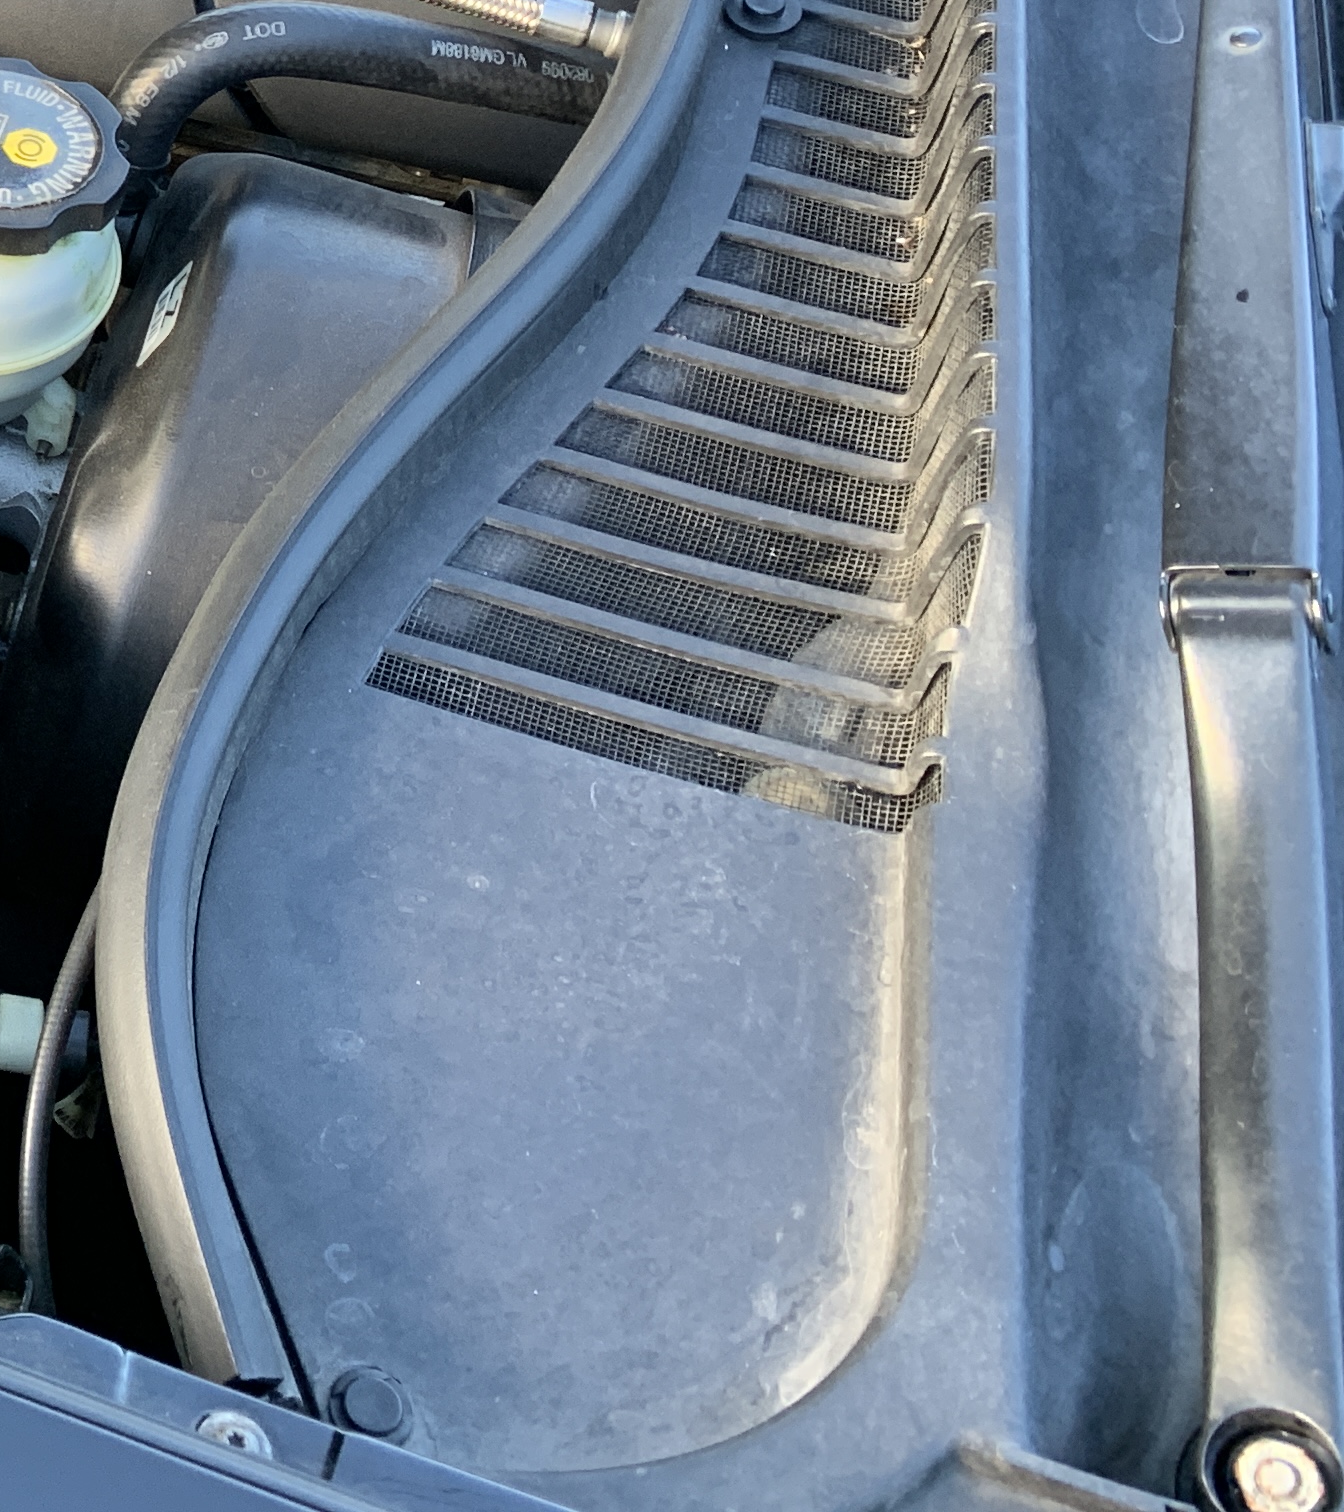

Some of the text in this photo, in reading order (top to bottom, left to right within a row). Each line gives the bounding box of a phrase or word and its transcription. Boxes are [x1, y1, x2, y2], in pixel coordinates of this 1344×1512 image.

[242, 21, 286, 41] DOT
[3, 80, 58, 107] FLUID
[28, 104, 96, 201] WARNING
